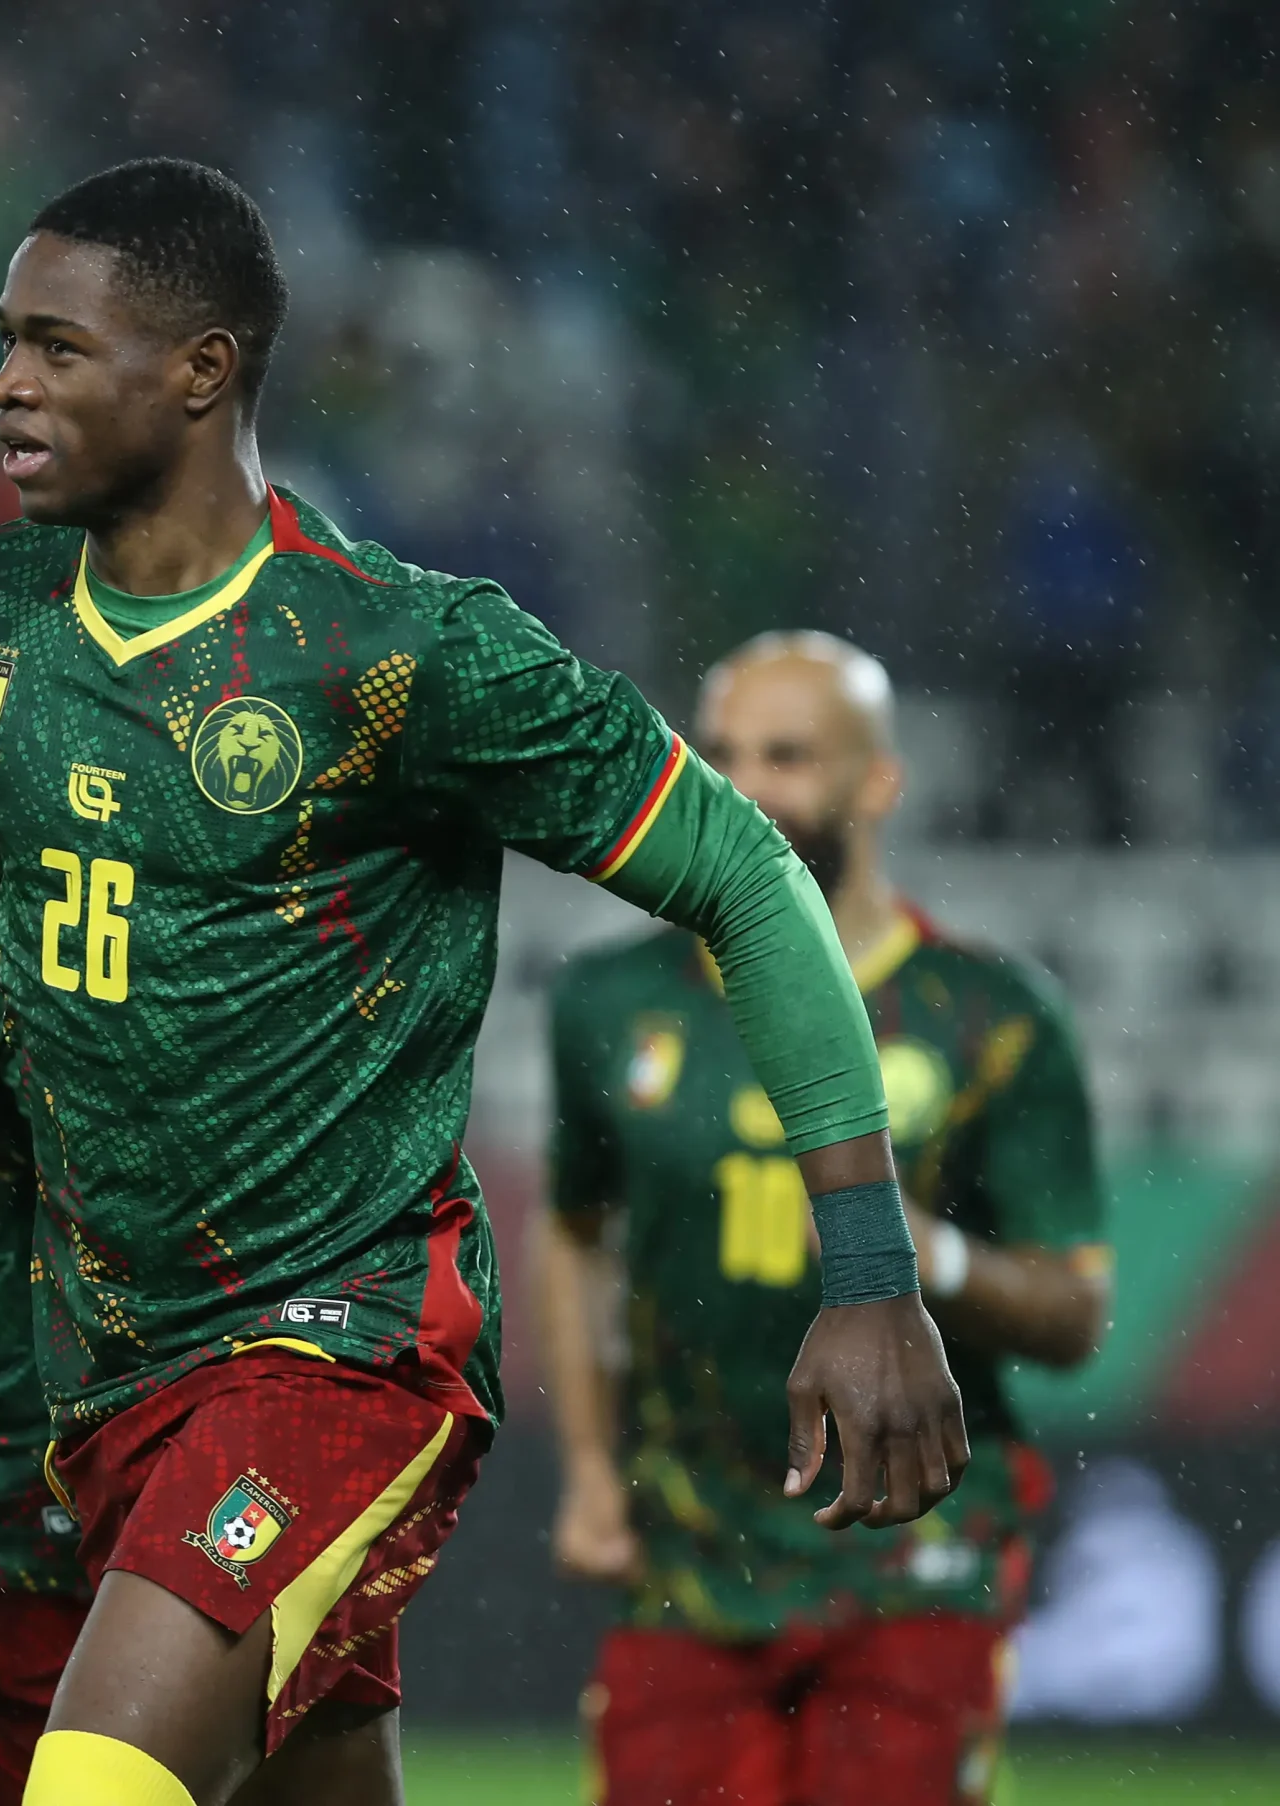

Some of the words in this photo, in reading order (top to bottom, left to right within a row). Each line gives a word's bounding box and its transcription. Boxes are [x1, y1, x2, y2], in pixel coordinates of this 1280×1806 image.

[71, 762, 127, 781] FOURTEEN
[41, 847, 135, 1003] 26
[240, 1481, 287, 1525] CAMEROUN
[200, 1539, 241, 1574] FECAFOOT
